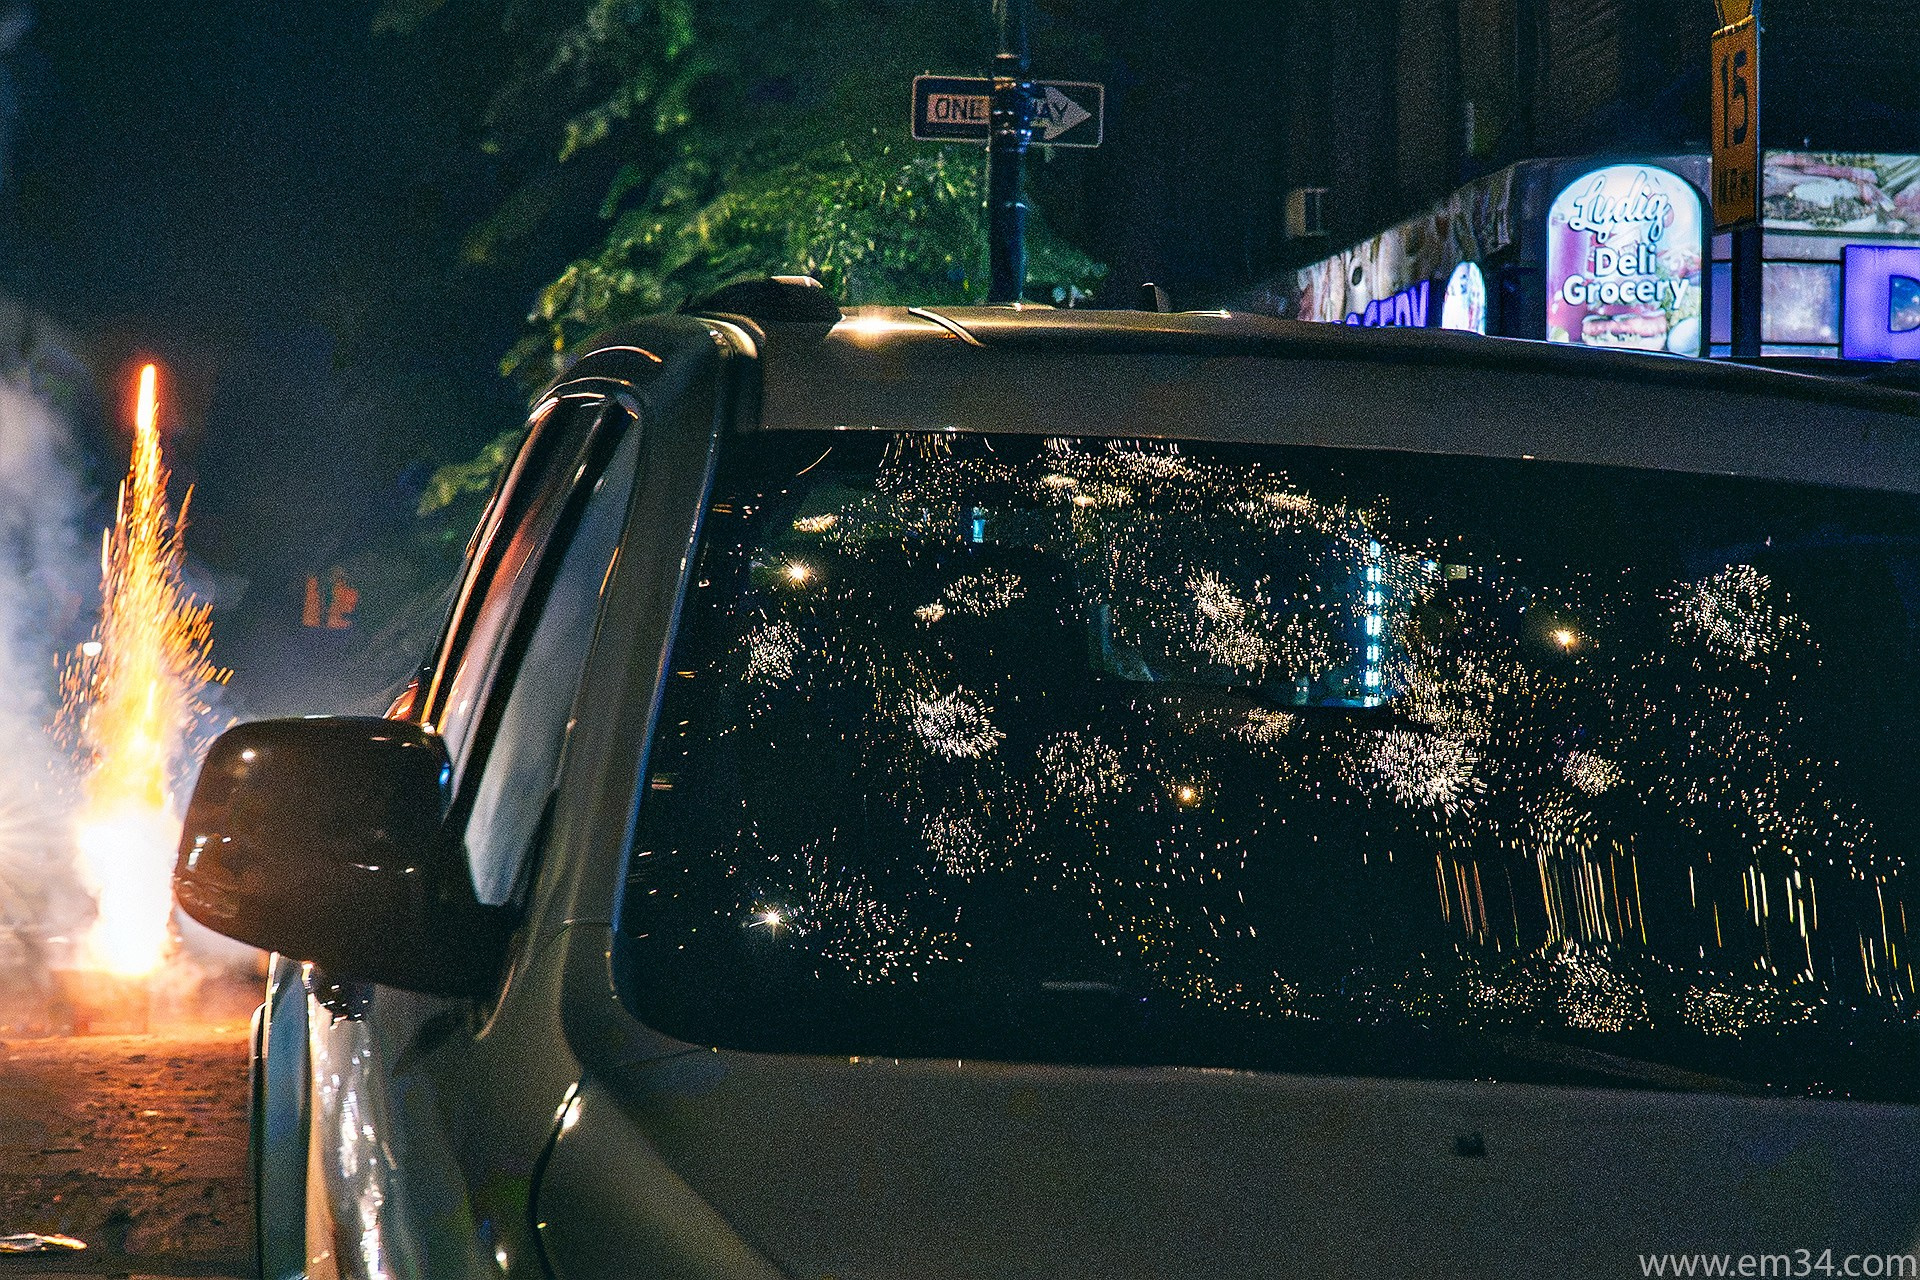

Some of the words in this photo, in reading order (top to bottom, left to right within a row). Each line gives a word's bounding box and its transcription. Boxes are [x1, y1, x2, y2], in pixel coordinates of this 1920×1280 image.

[935, 98, 984, 120] ONE
[1720, 50, 1749, 148] 15
[1568, 170, 1671, 244] Lydig
[1594, 243, 1656, 277] Deli
[1562, 274, 1689, 310] Grocery
